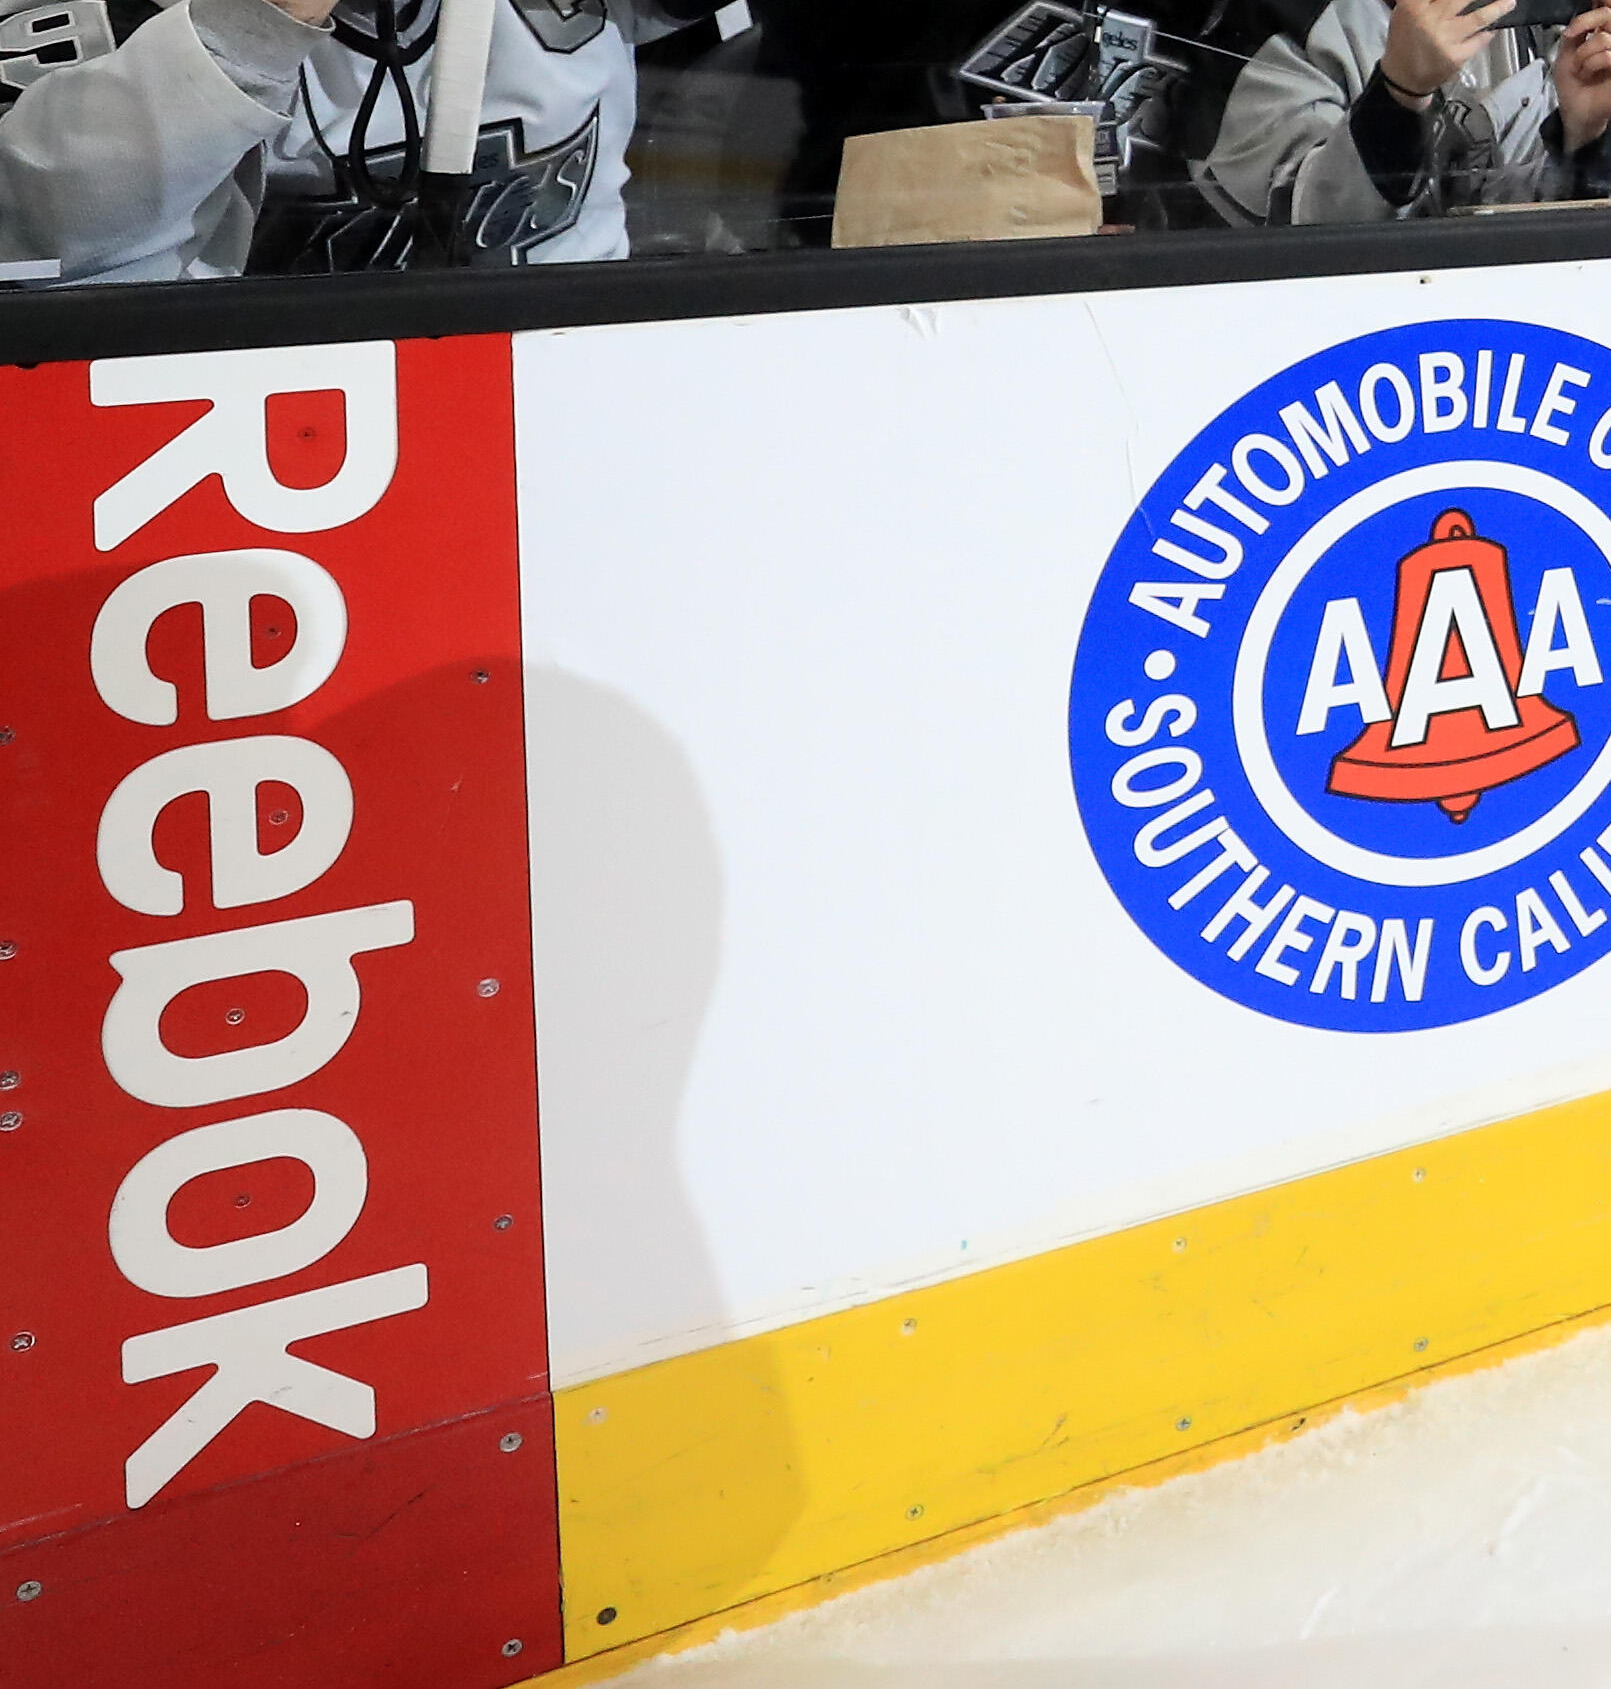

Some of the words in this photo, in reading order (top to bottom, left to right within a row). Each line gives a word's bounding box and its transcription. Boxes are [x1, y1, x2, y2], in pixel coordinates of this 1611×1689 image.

[1128, 348, 1592, 640] AUTOMOBILE
[1295, 564, 1604, 749] AAA
[88, 338, 430, 1510] Reebok
[1104, 695, 1433, 1004] SOUTHERN
